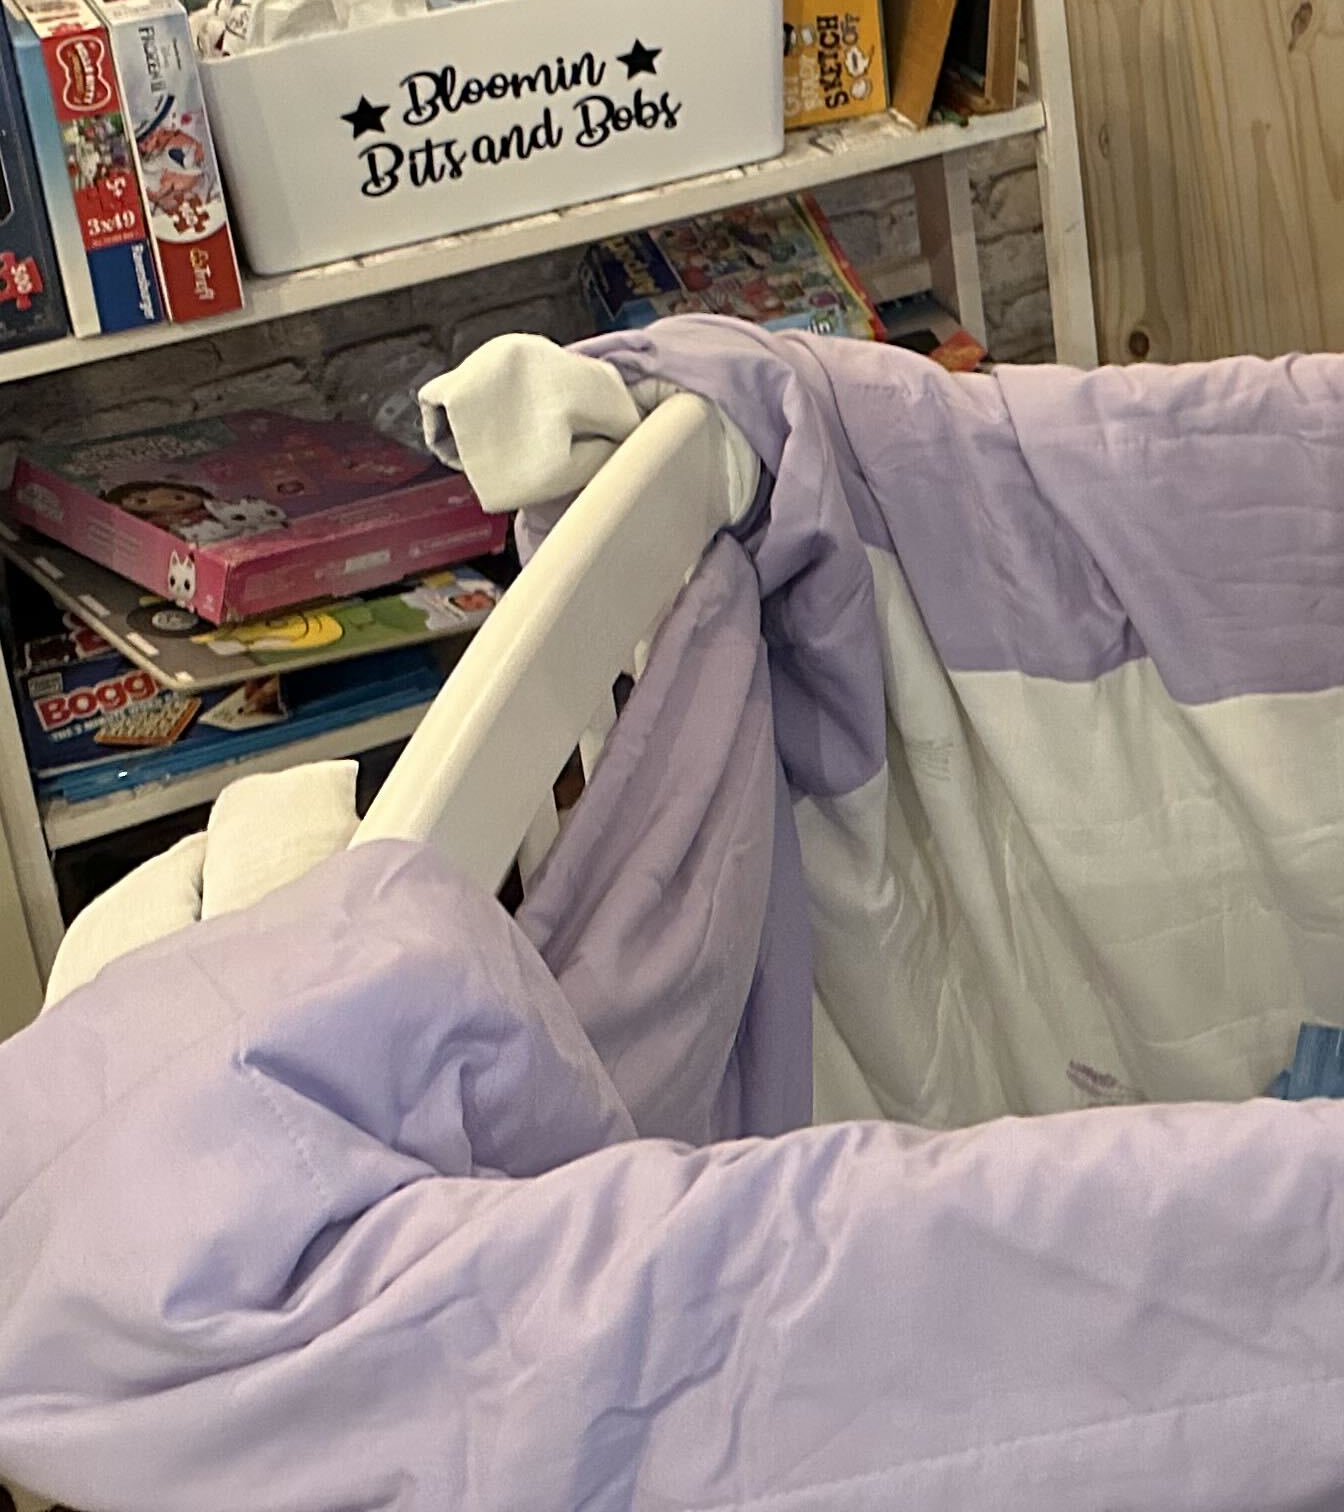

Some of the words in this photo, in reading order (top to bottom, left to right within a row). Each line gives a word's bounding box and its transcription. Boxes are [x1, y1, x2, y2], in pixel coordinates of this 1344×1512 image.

[399, 51, 606, 126] Bloomin
[815, 14, 849, 110] SKETCH
[358, 138, 466, 198] Bits
[472, 107, 563, 165] and
[572, 88, 682, 148] Bobs
[87, 210, 136, 236] 3x49
[33, 669, 159, 732] Bogg
